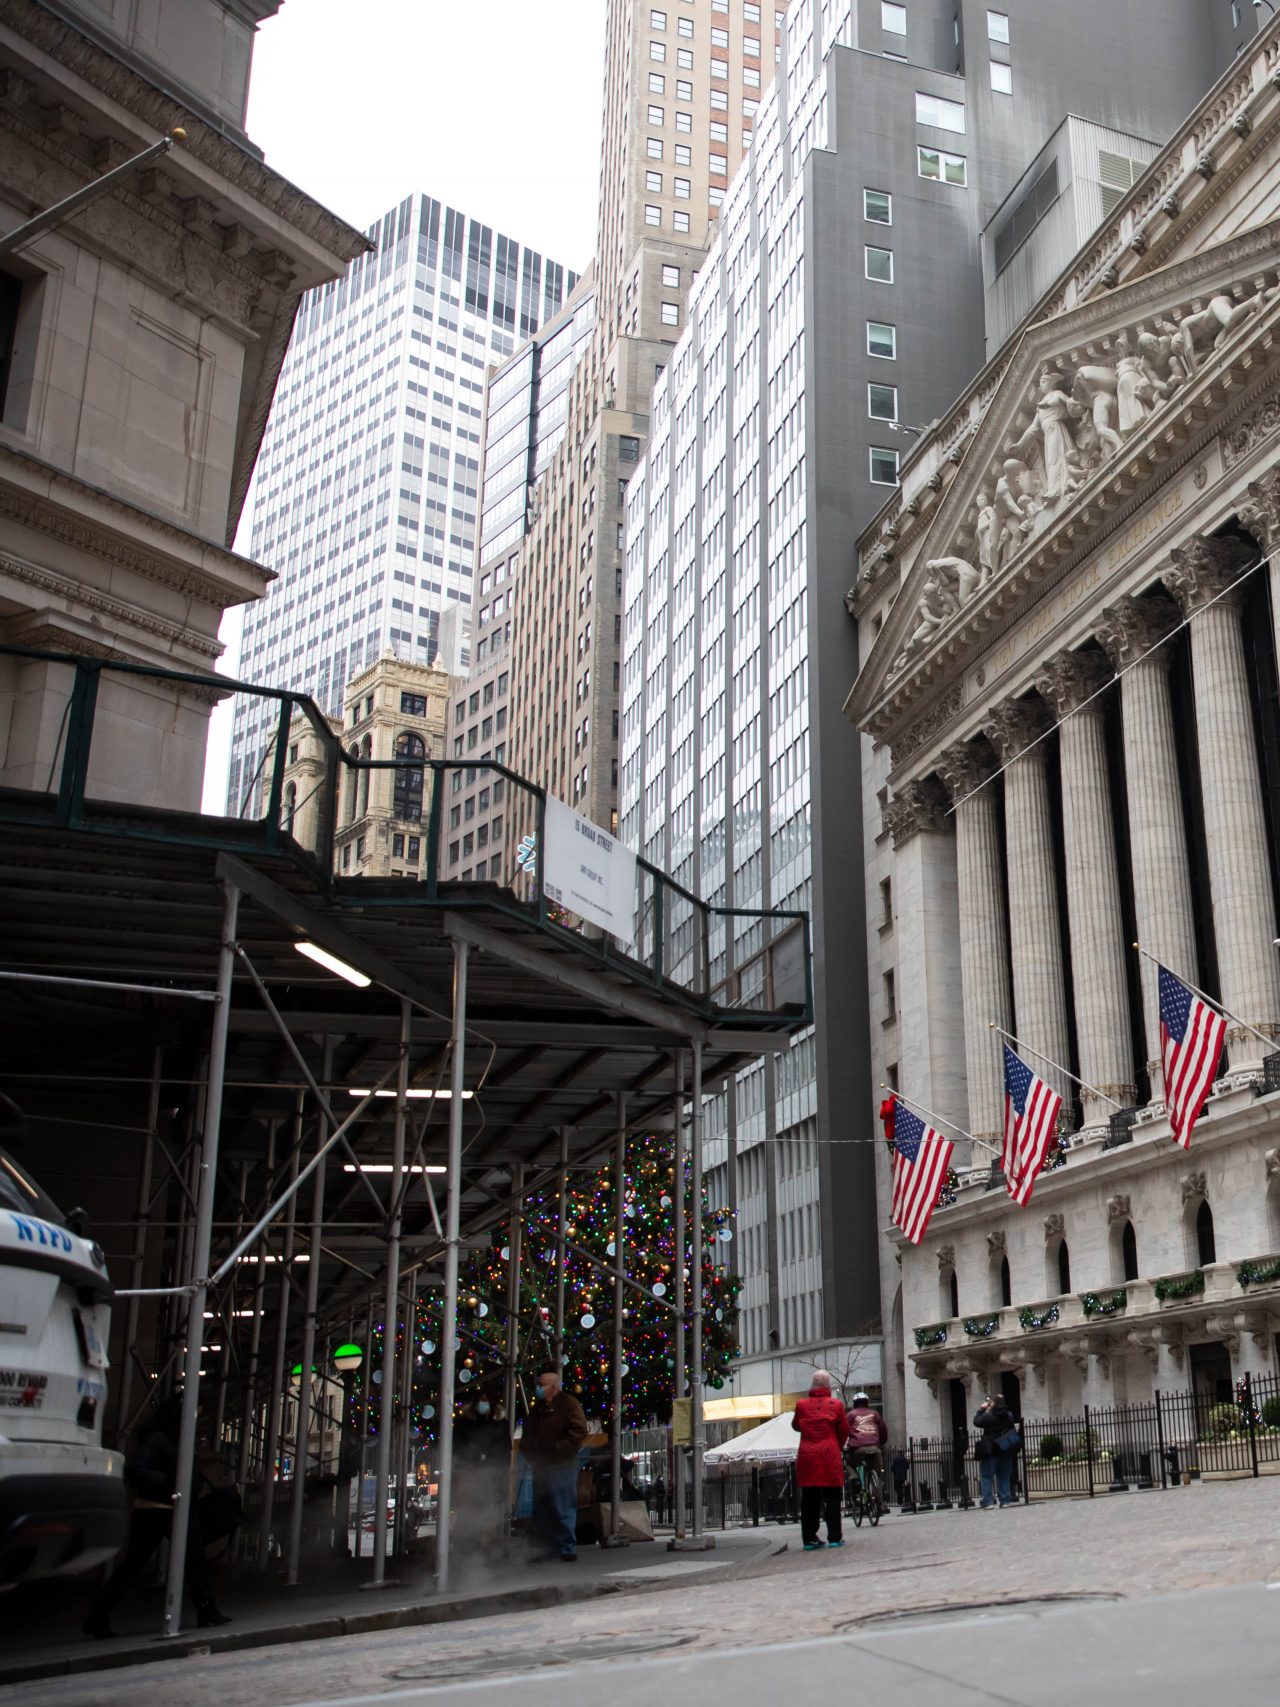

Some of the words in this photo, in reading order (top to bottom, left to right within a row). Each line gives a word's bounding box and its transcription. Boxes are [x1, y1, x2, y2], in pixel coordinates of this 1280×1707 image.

[991, 638, 1017, 674] NEW
[1023, 607, 1056, 645] YORK
[1061, 562, 1102, 611] STOCK
[1107, 487, 1183, 570] EXCHANGE
[581, 824, 596, 842] BROAD
[597, 833, 614, 853] STREET
[10, 1213, 72, 1253] NYPD
